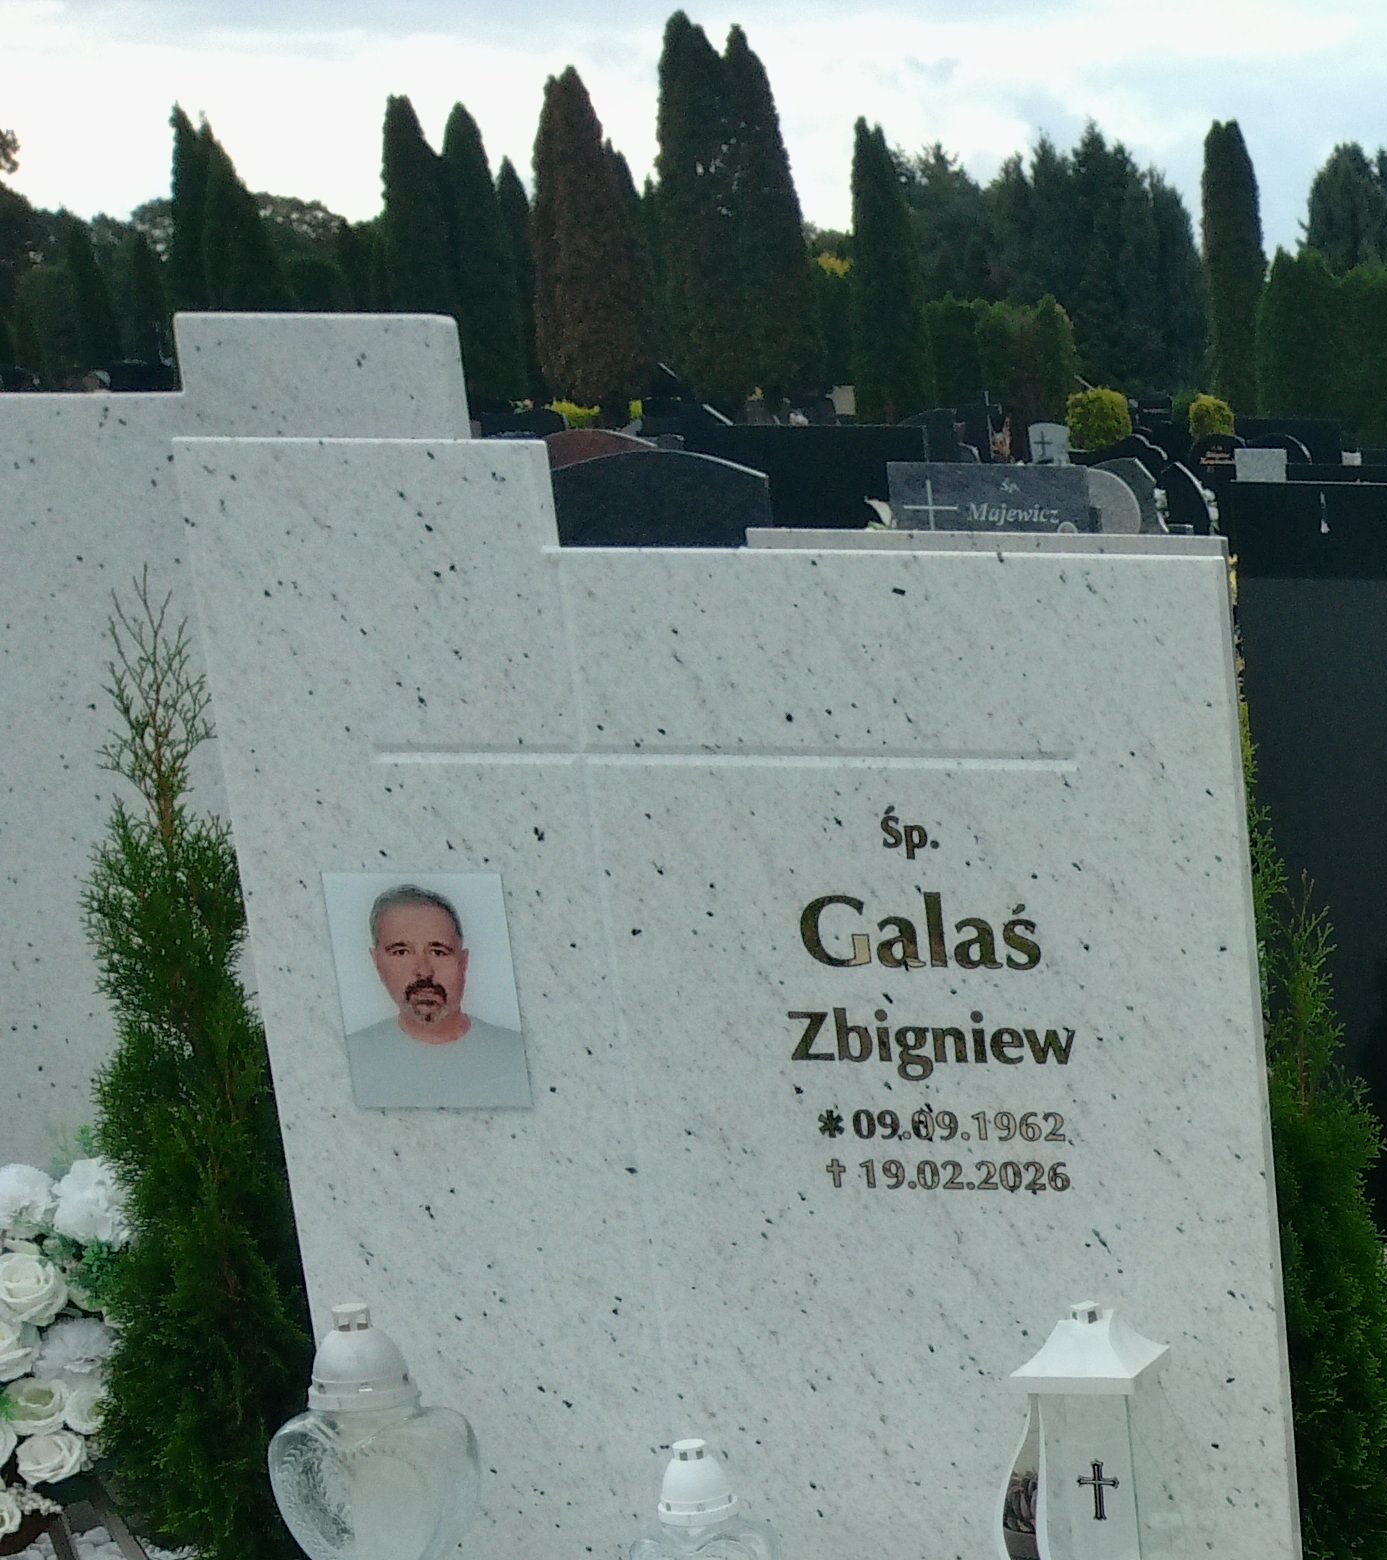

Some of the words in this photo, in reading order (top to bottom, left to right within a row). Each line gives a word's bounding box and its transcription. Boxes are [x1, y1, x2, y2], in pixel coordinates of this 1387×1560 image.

[967, 502, 1060, 526] Majewicz
[880, 805, 940, 860] Śp.
[800, 890, 1042, 971] Galaś
[787, 1007, 1076, 1082] Zbigniew
[852, 1108, 1066, 1142] 09.09.1962
[859, 1159, 1071, 1192] 19.02.2026
